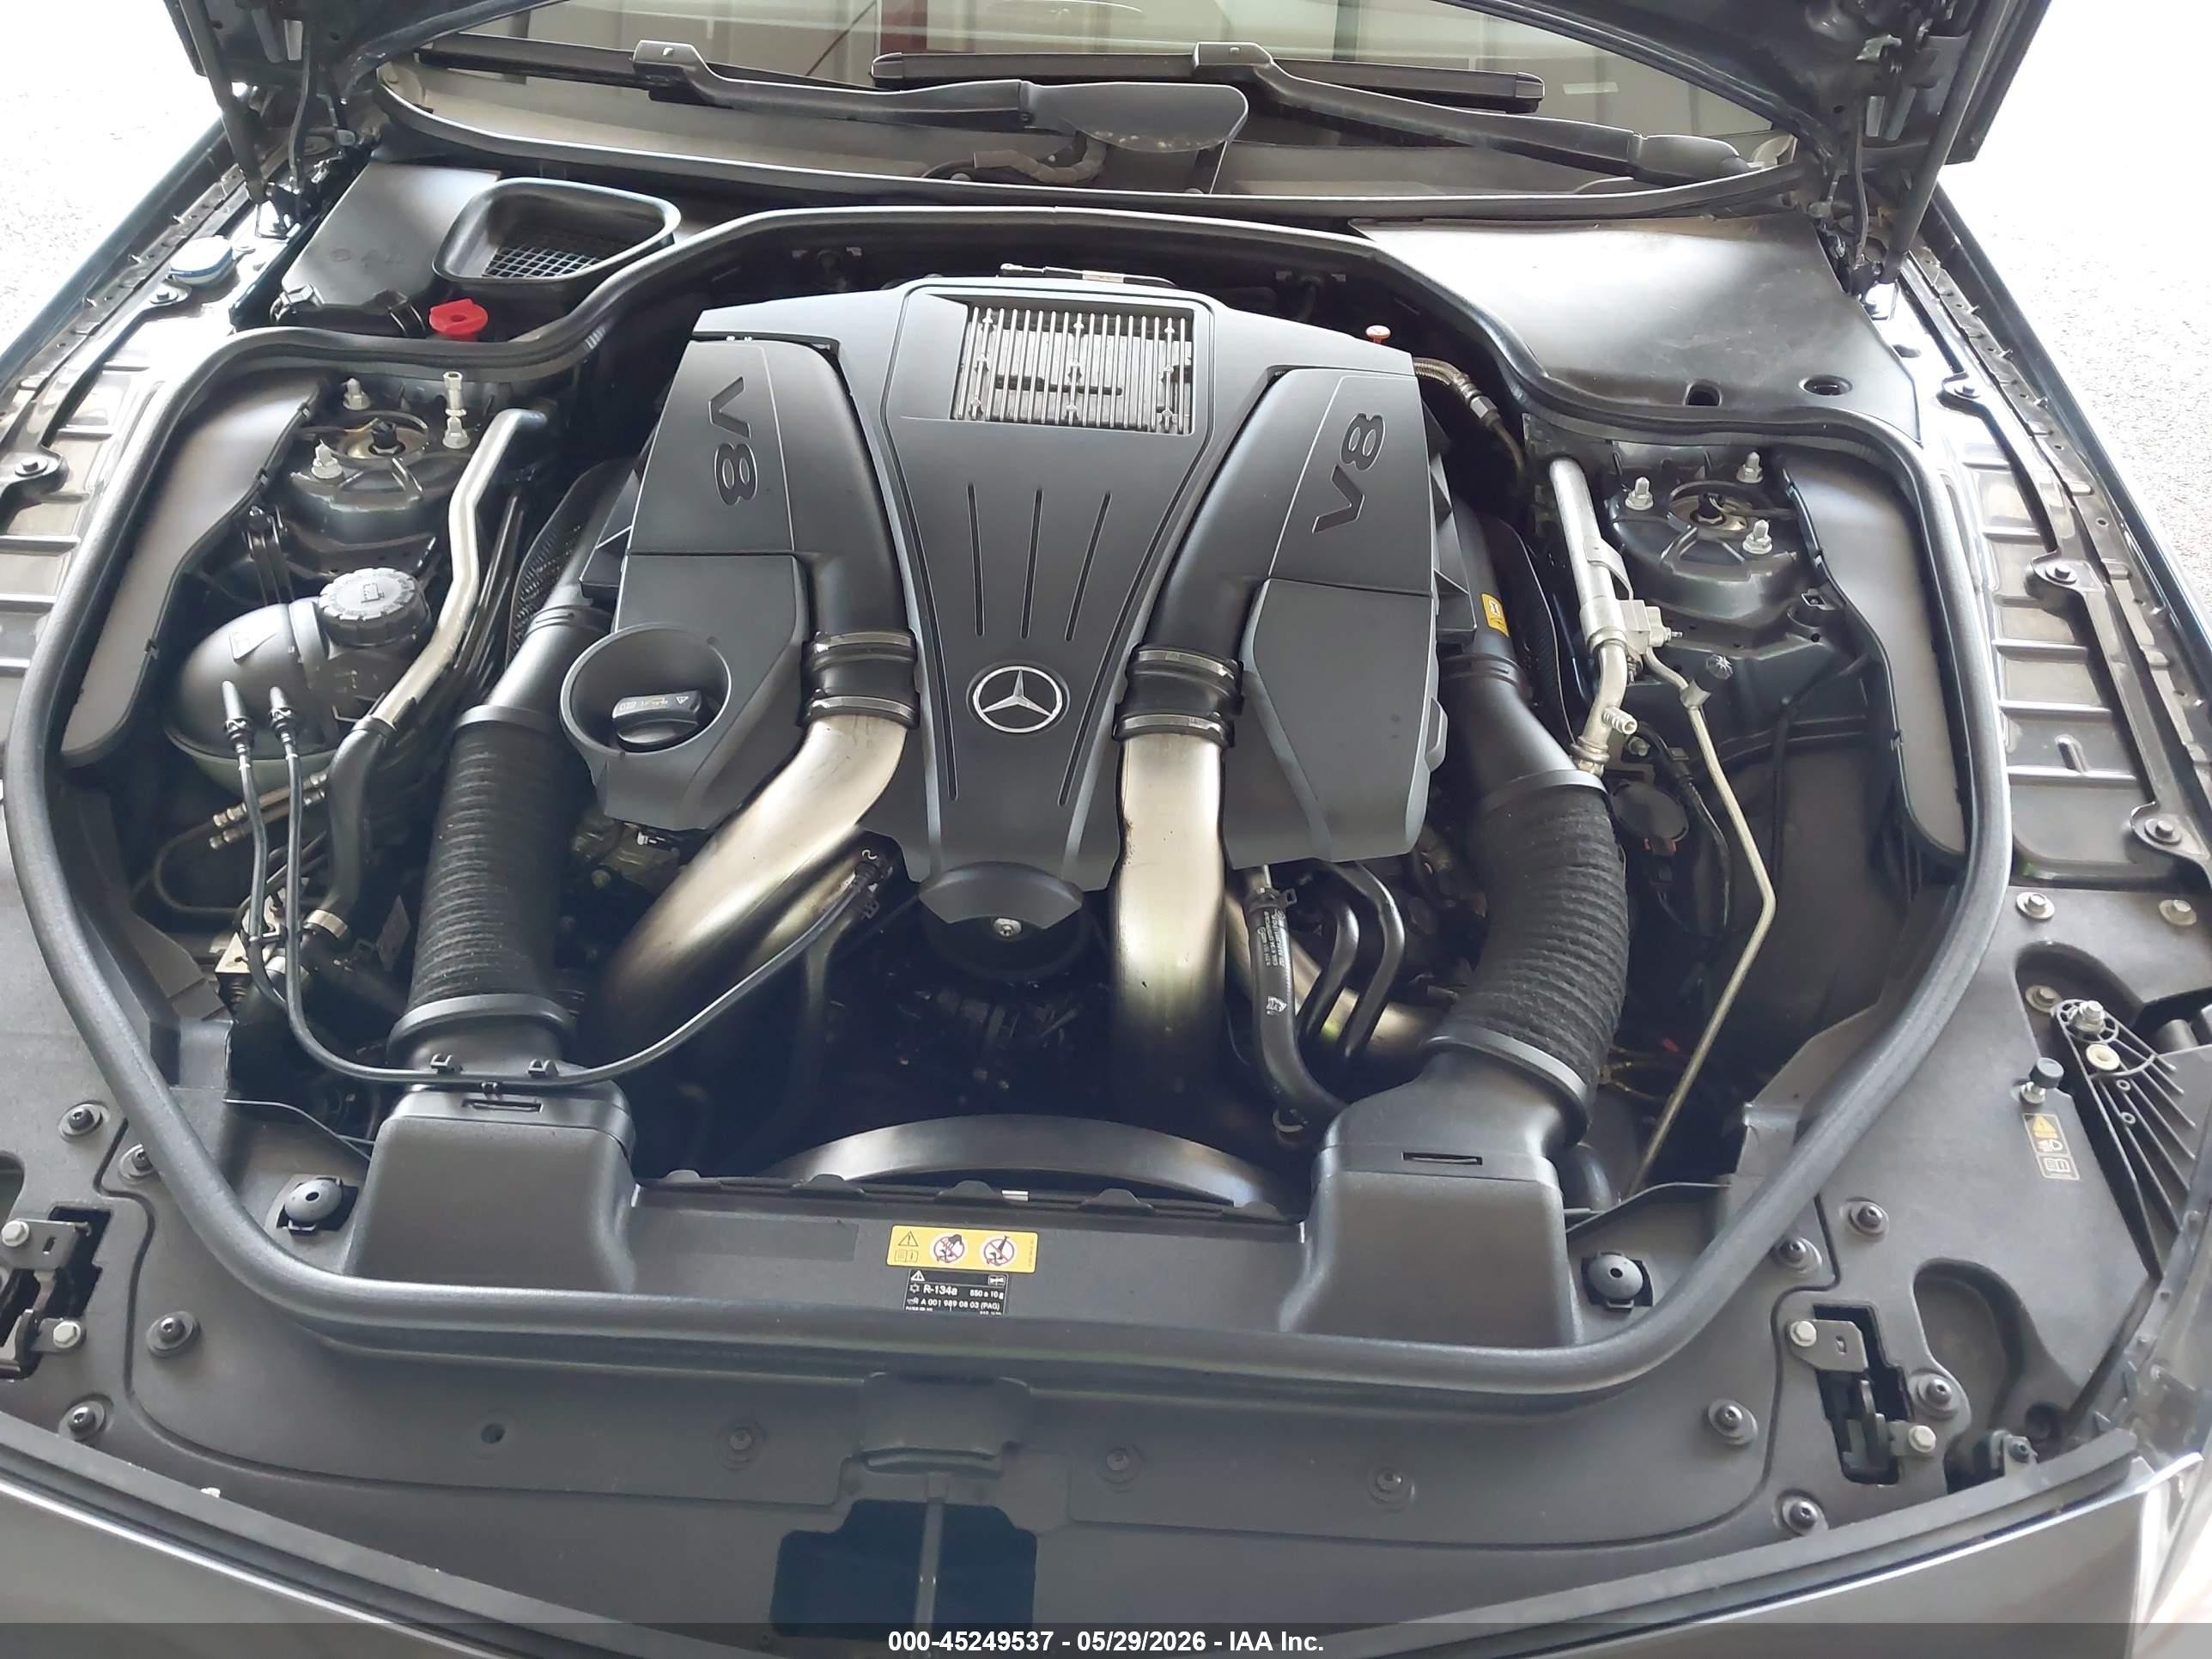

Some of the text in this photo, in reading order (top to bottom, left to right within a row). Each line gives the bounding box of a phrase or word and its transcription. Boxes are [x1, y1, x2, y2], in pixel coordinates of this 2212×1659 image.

[708, 376, 757, 507] V8
[1312, 413, 1386, 533] V8
[923, 1284, 957, 1296] R-134a
[927, 1298, 941, 1307] 001
[981, 1303, 1000, 1311] (PAG)
